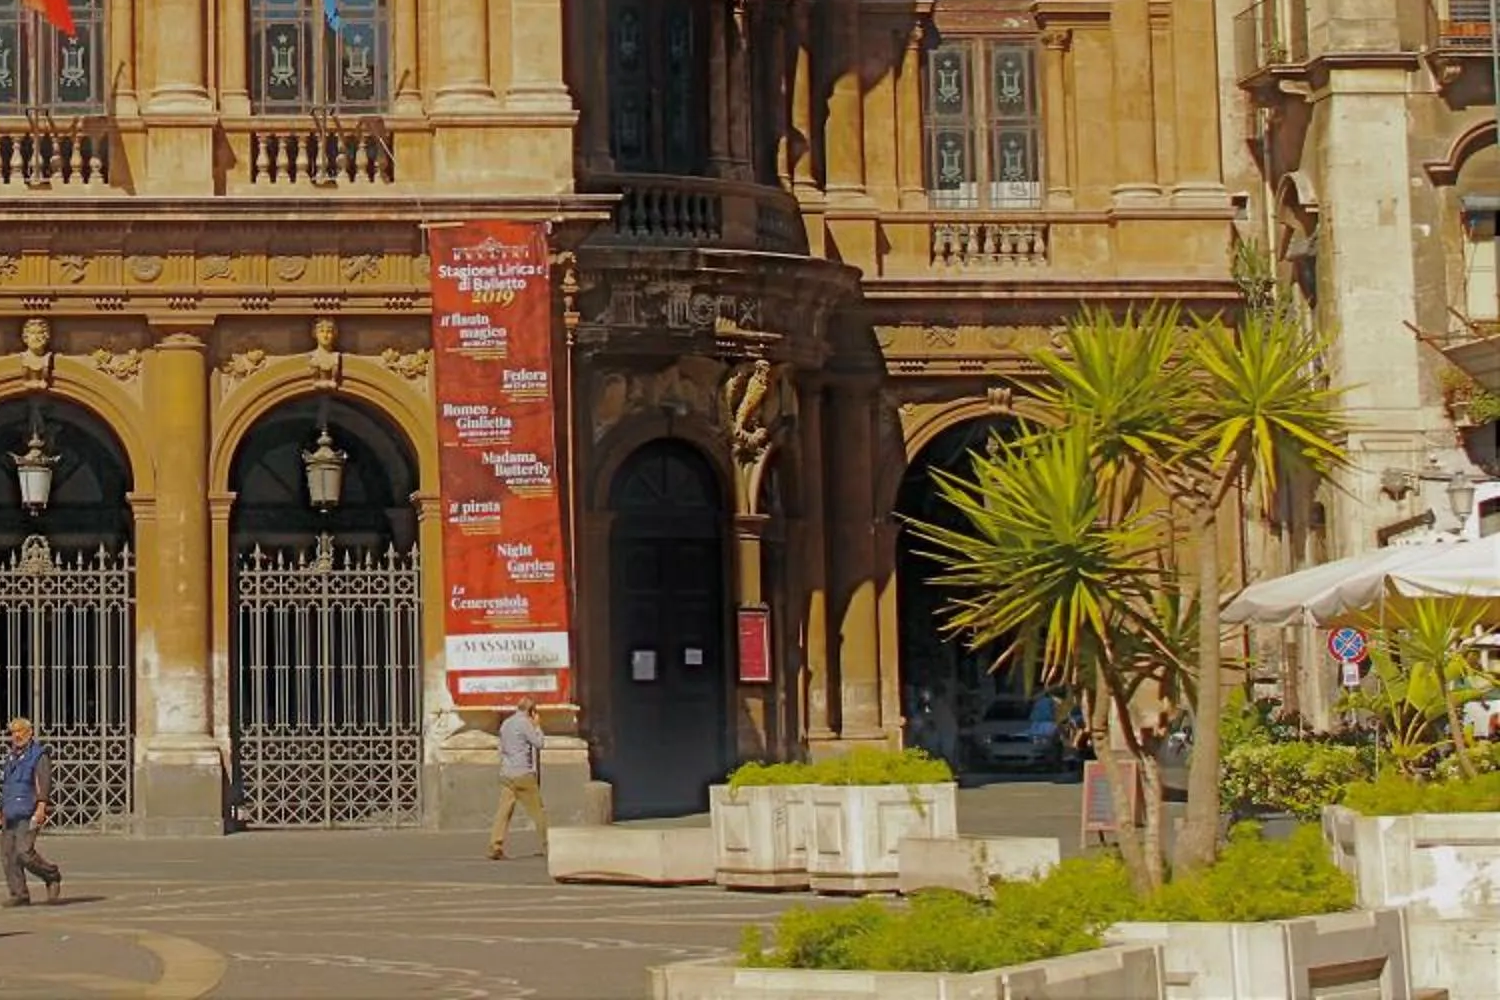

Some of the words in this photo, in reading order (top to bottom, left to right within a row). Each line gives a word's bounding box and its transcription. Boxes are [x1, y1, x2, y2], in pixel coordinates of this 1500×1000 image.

[438, 264, 498, 280] Stagione
[499, 263, 535, 277] Lirica
[458, 278, 471, 291] di
[473, 278, 527, 291] Balletto
[471, 291, 515, 308] 2019
[503, 368, 547, 382] Fedora
[443, 404, 489, 417] Romeo
